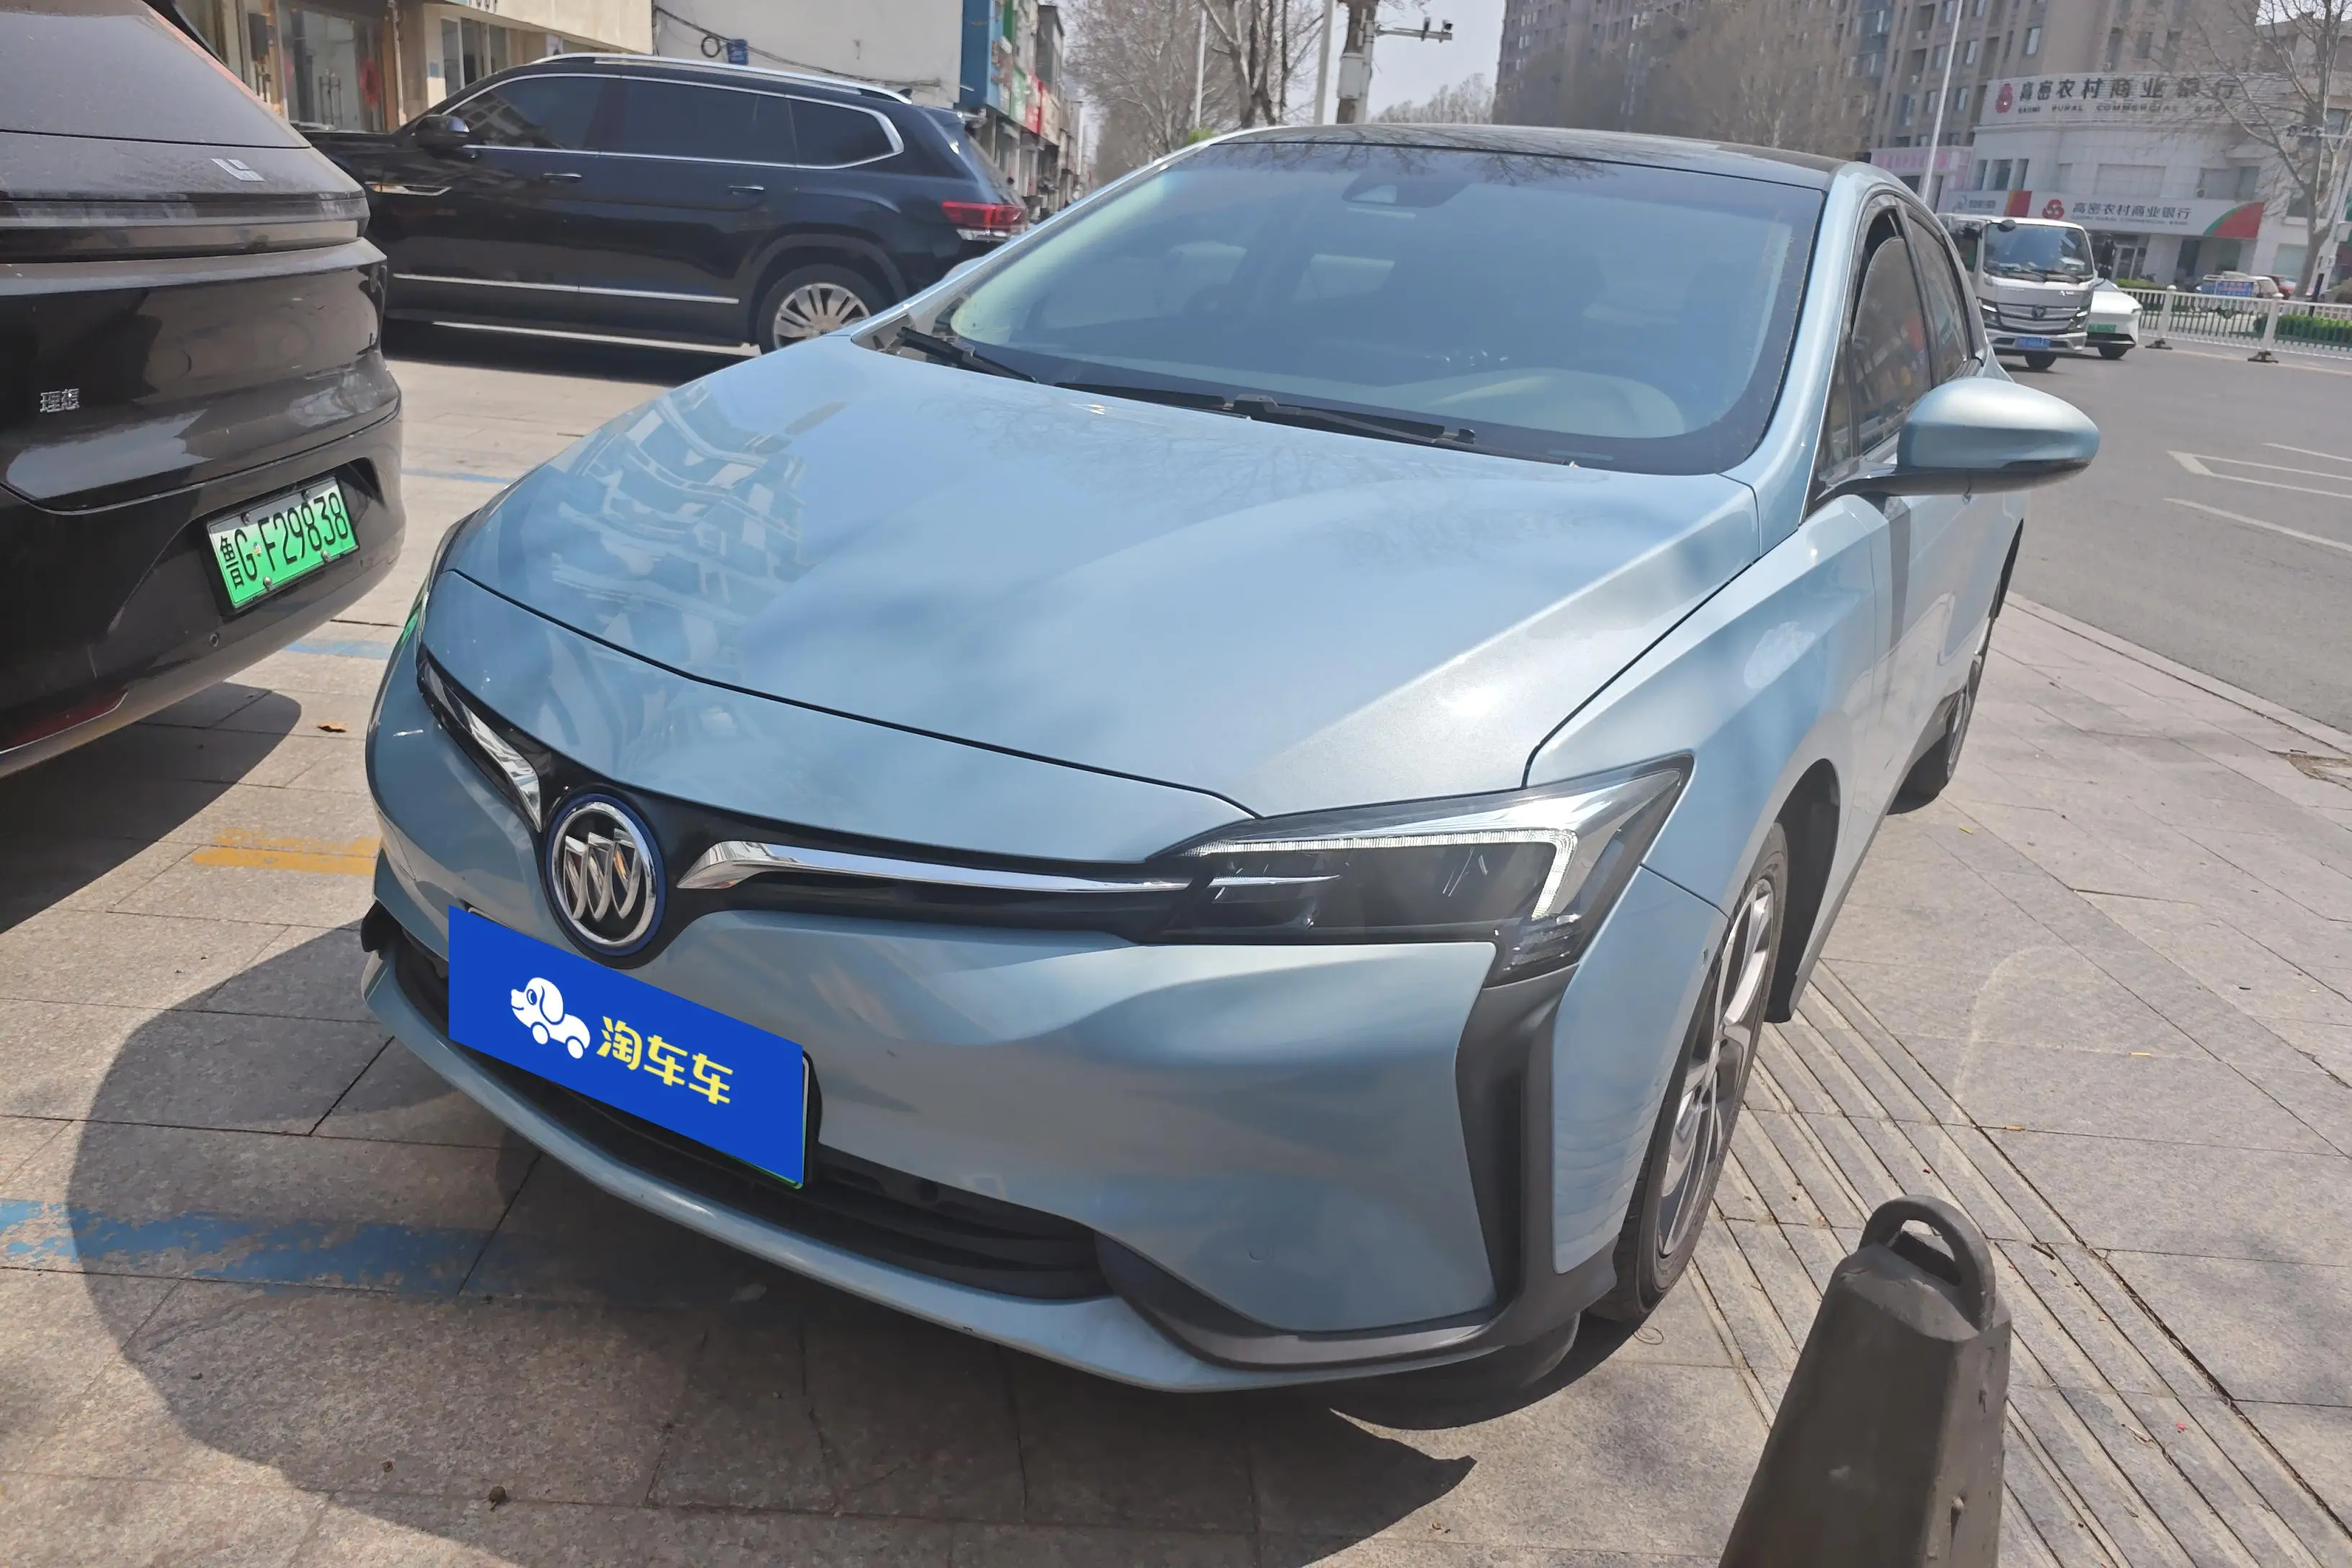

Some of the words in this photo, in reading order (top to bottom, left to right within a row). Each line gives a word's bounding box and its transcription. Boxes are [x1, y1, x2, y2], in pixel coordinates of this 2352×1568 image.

[2072, 202, 2191, 219] 高密农村商业银行
[40, 388, 80, 413] 理想
